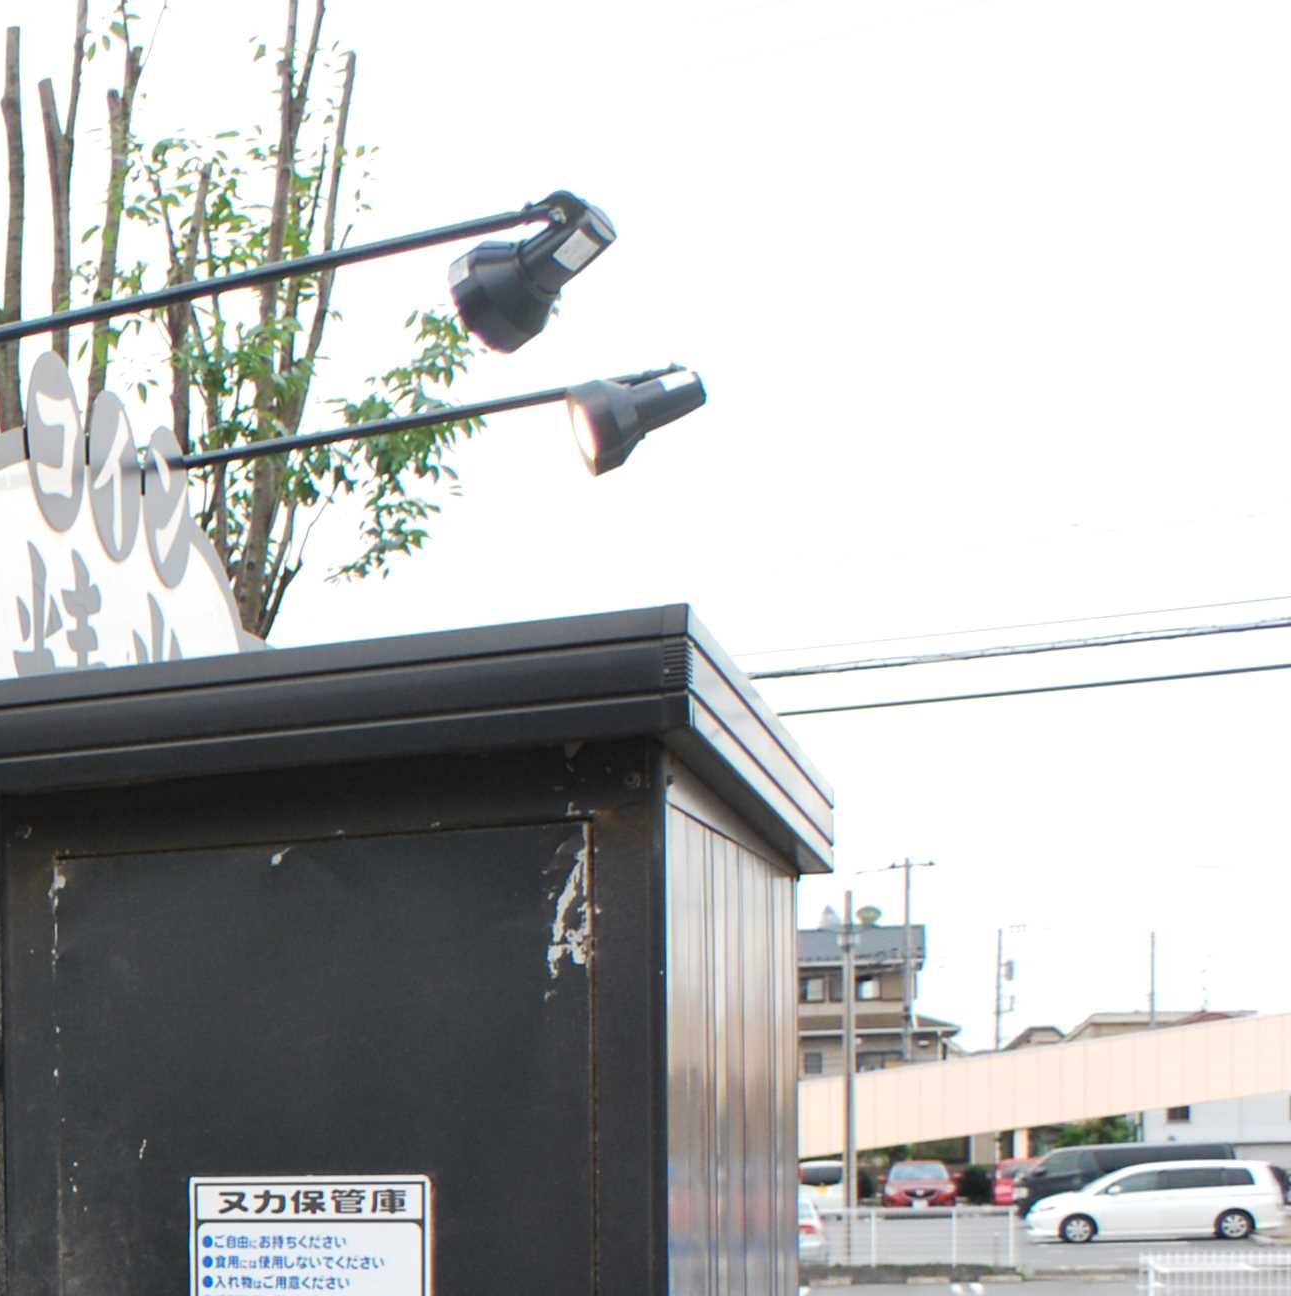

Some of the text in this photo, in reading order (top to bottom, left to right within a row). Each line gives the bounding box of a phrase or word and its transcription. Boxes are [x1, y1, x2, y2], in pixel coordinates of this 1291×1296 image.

[36, 392, 188, 566] コイン
[218, 1189, 407, 1215] ヌカ保管庫
[213, 1235, 347, 1250] ご自由にお持ちください
[214, 1255, 386, 1270] 食用には使用しないでください
[214, 1275, 351, 1290] 入れ物はご用意ください
